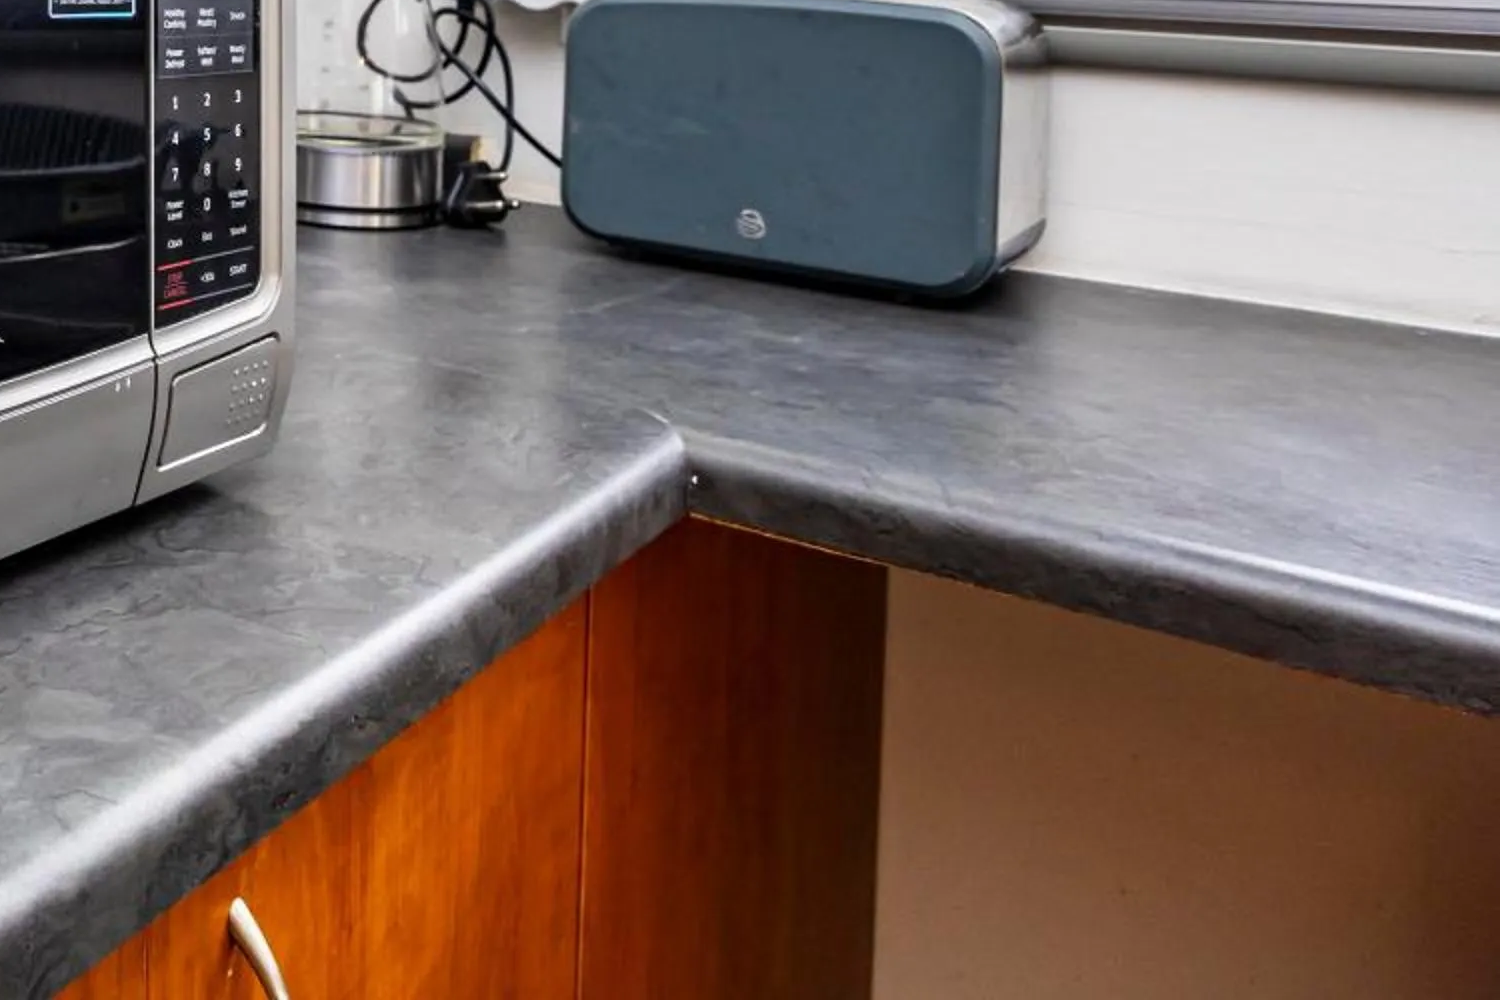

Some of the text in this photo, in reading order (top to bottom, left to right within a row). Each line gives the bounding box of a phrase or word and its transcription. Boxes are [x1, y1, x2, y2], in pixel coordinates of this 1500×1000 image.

[203, 92, 211, 107] 2
[171, 123, 242, 145] 4 5 6
[171, 157, 242, 182] 7 8 9
[203, 197, 211, 211] 0
